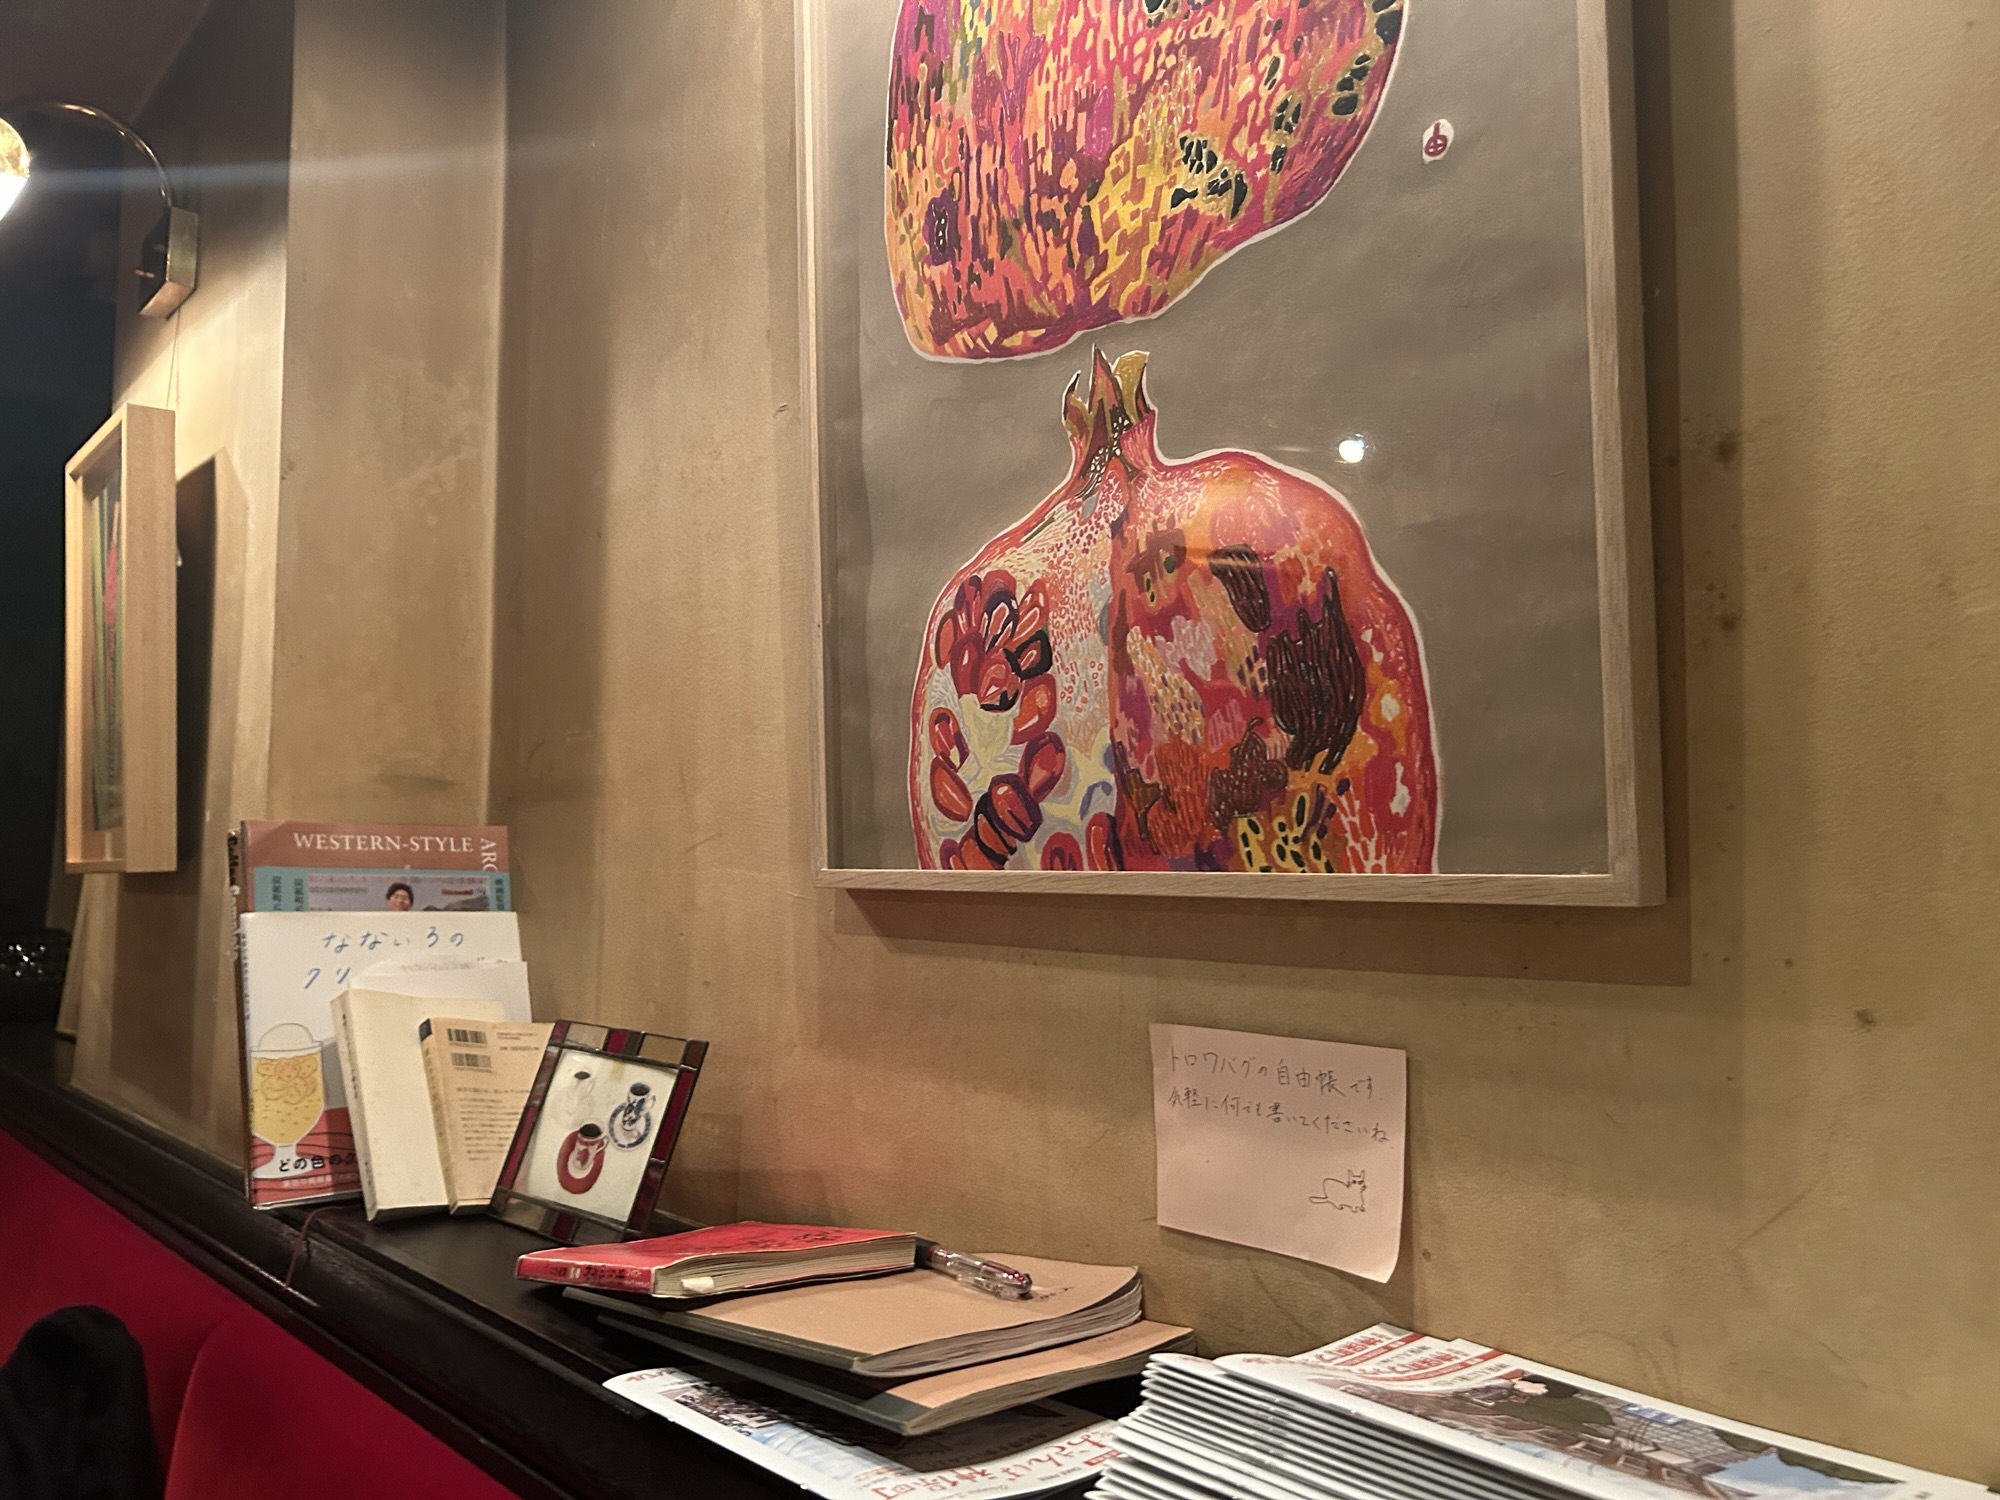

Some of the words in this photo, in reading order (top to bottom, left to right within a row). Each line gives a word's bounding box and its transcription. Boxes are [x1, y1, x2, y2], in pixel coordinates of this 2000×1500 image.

[293, 832, 474, 853] WESTERN-STYLE
[322, 926, 464, 954] なないろの
[304, 967, 352, 990] クリ
